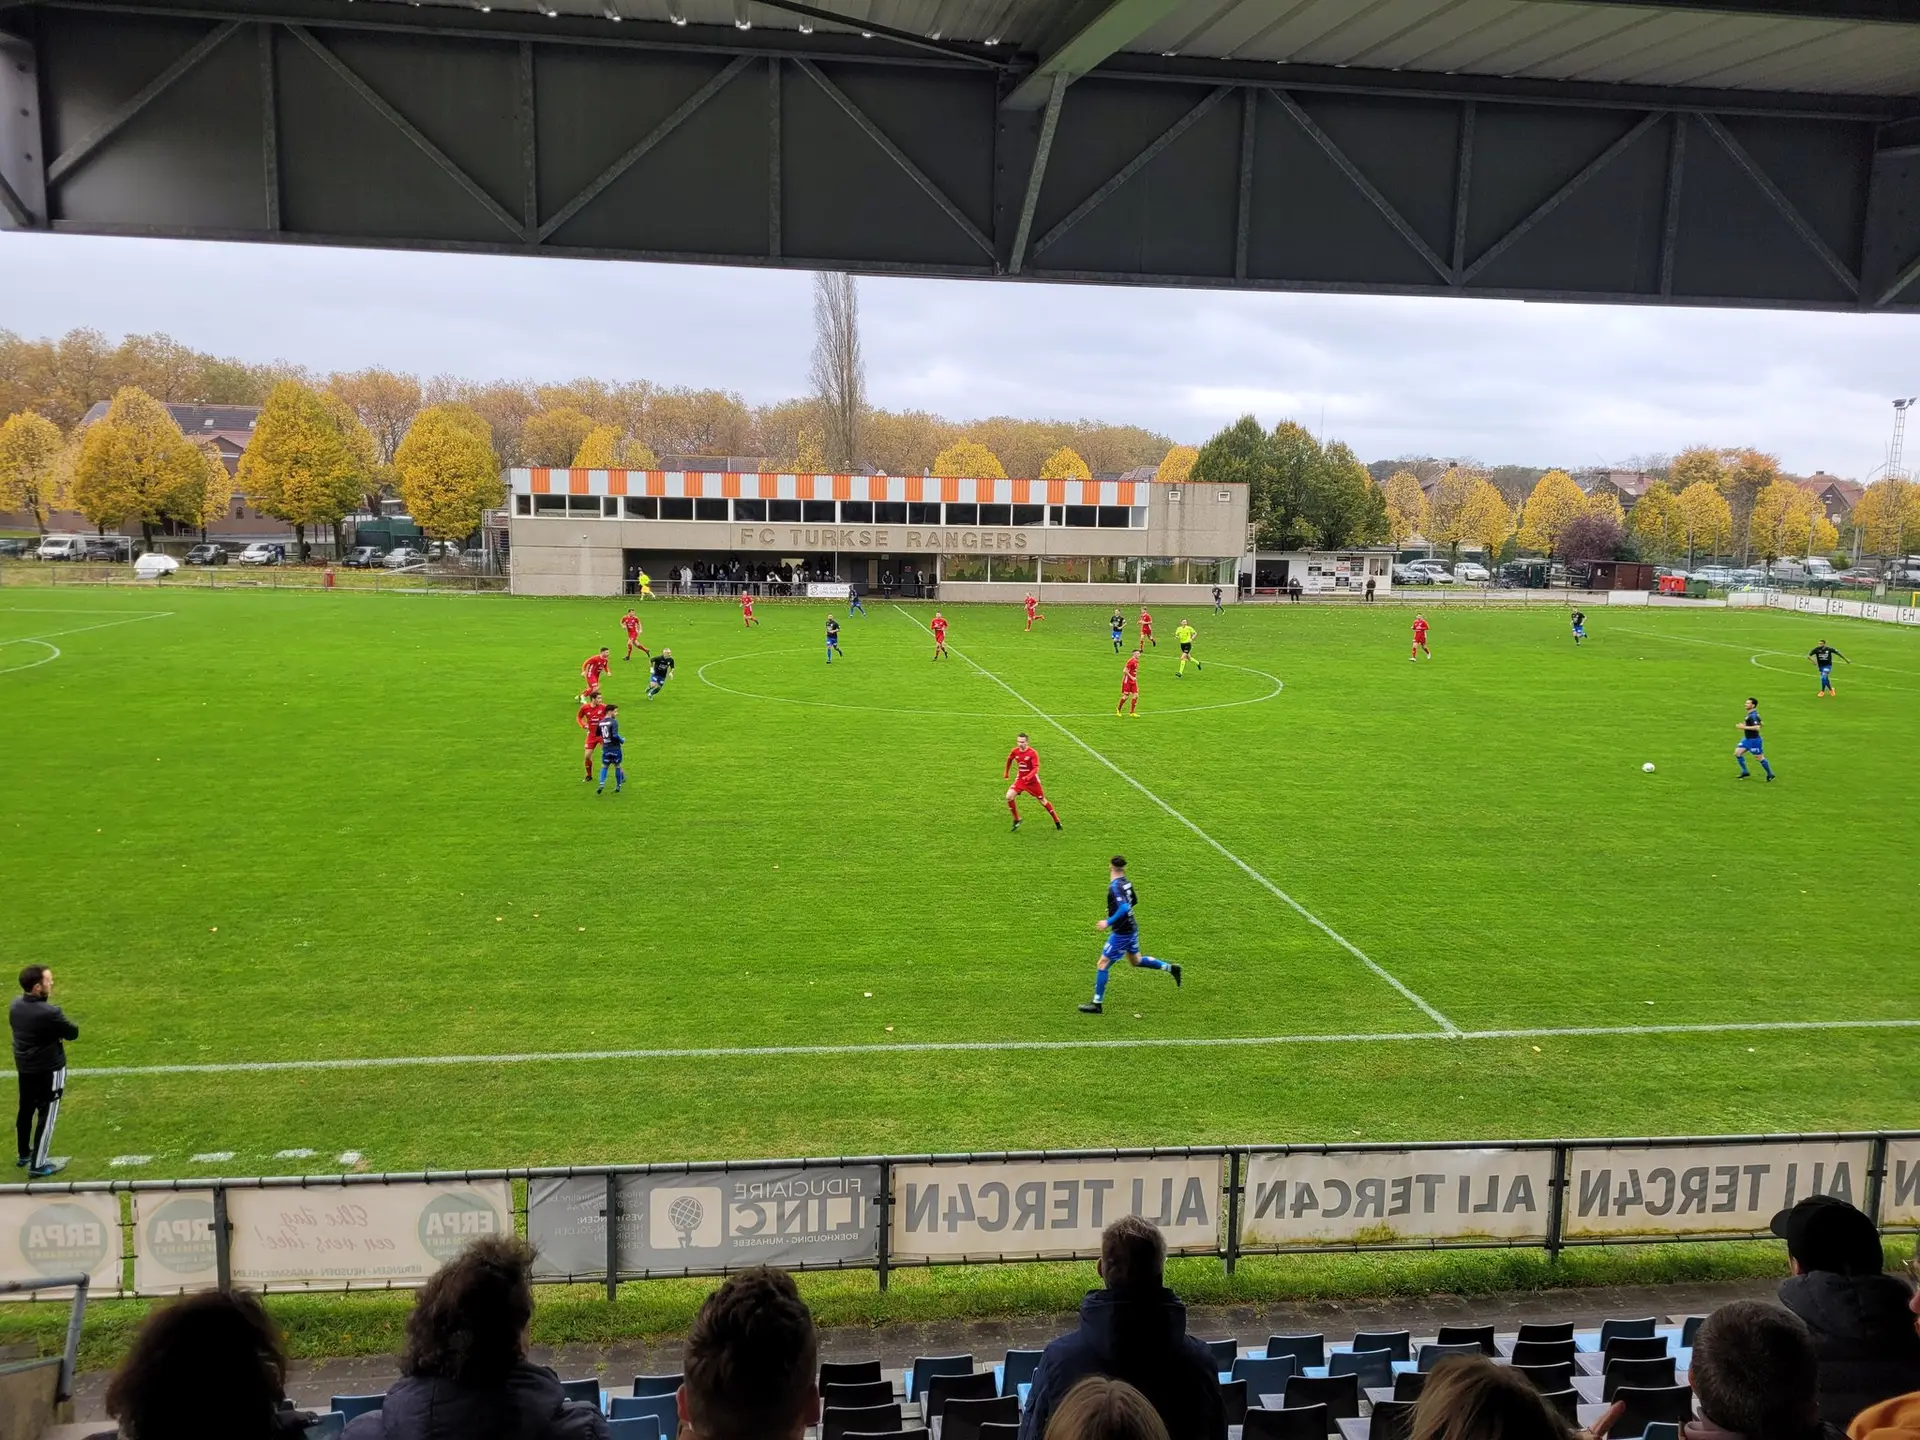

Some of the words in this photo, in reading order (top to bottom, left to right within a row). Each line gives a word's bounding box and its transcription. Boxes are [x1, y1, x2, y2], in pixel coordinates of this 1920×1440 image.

[740, 528, 776, 546] FC
[790, 528, 889, 547] TURKSE
[906, 530, 1028, 549] RANGERS
[601, 726, 609, 738] 10
